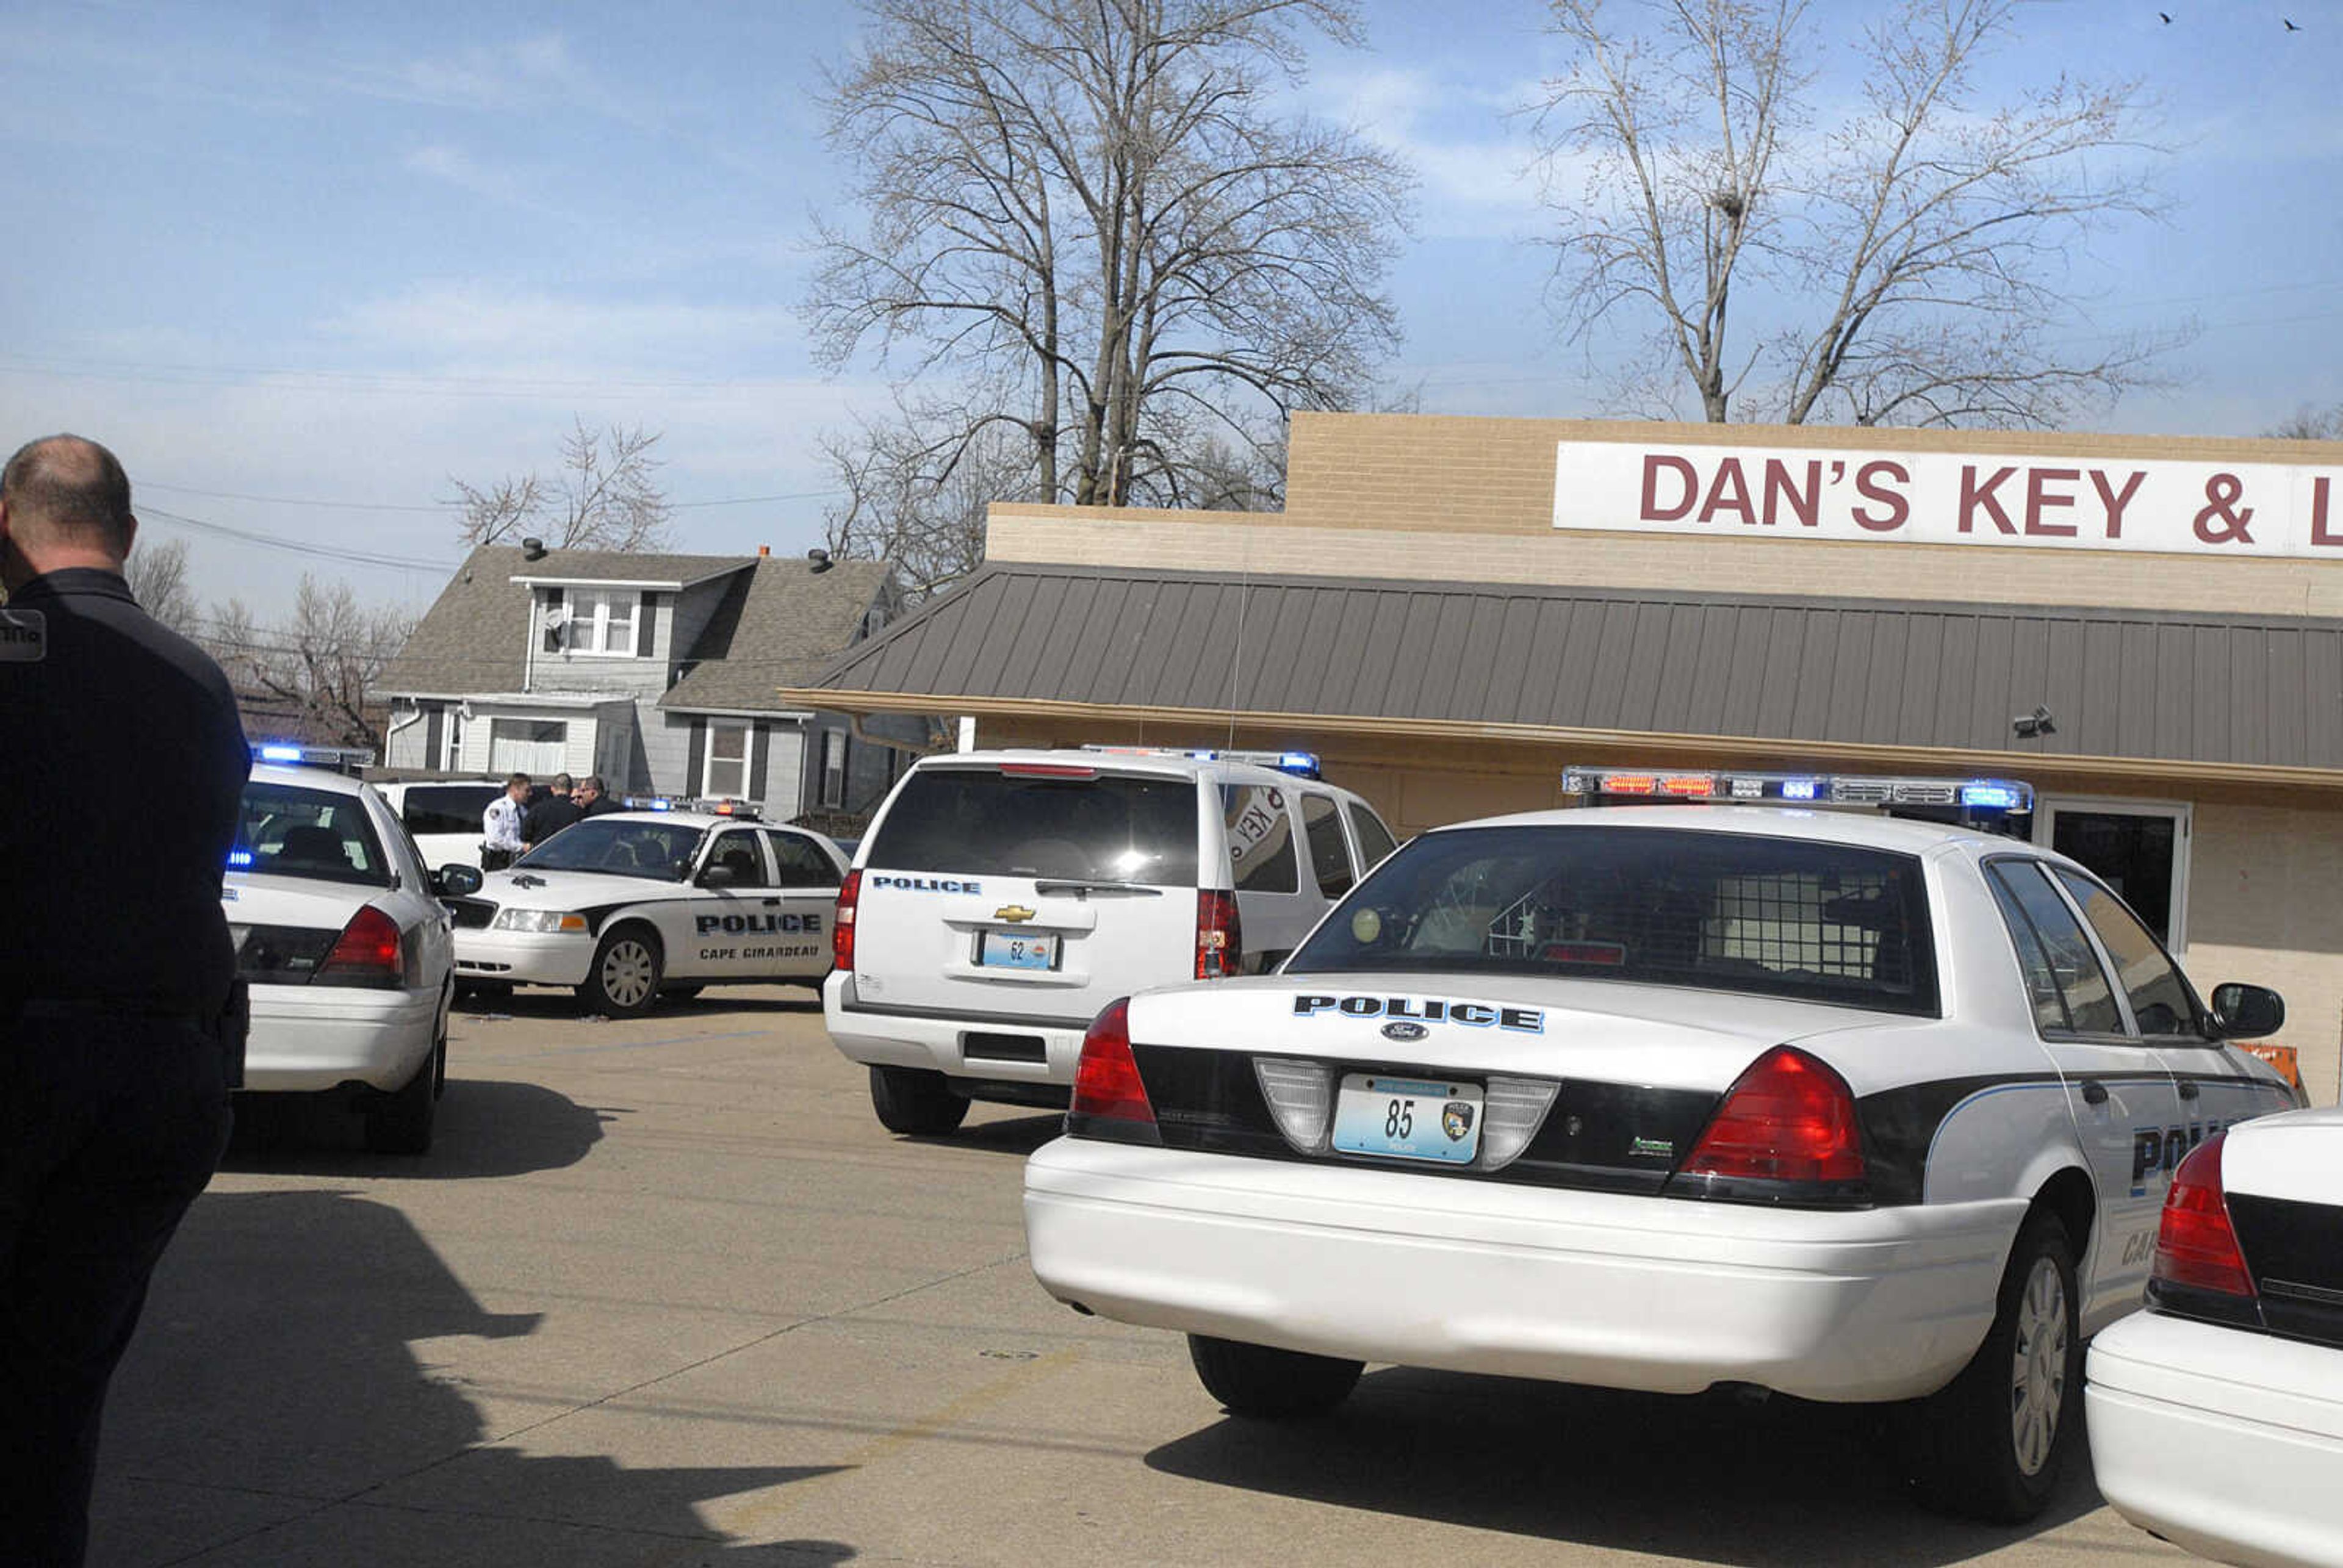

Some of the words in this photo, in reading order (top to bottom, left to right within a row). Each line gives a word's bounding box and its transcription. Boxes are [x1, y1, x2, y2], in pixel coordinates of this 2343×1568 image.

[1640, 455, 1910, 532] DAN'S
[1957, 465, 2148, 539] KEY
[2193, 472, 2256, 544] &
[873, 876, 982, 895] POLICE
[694, 914, 821, 936] POLICE
[700, 948, 737, 960] CAPE
[743, 946, 819, 958] GIRARDEAU
[1010, 941, 1024, 961] 62
[1294, 994, 1544, 1034] POLICE
[1385, 1099, 1414, 1138] 85
